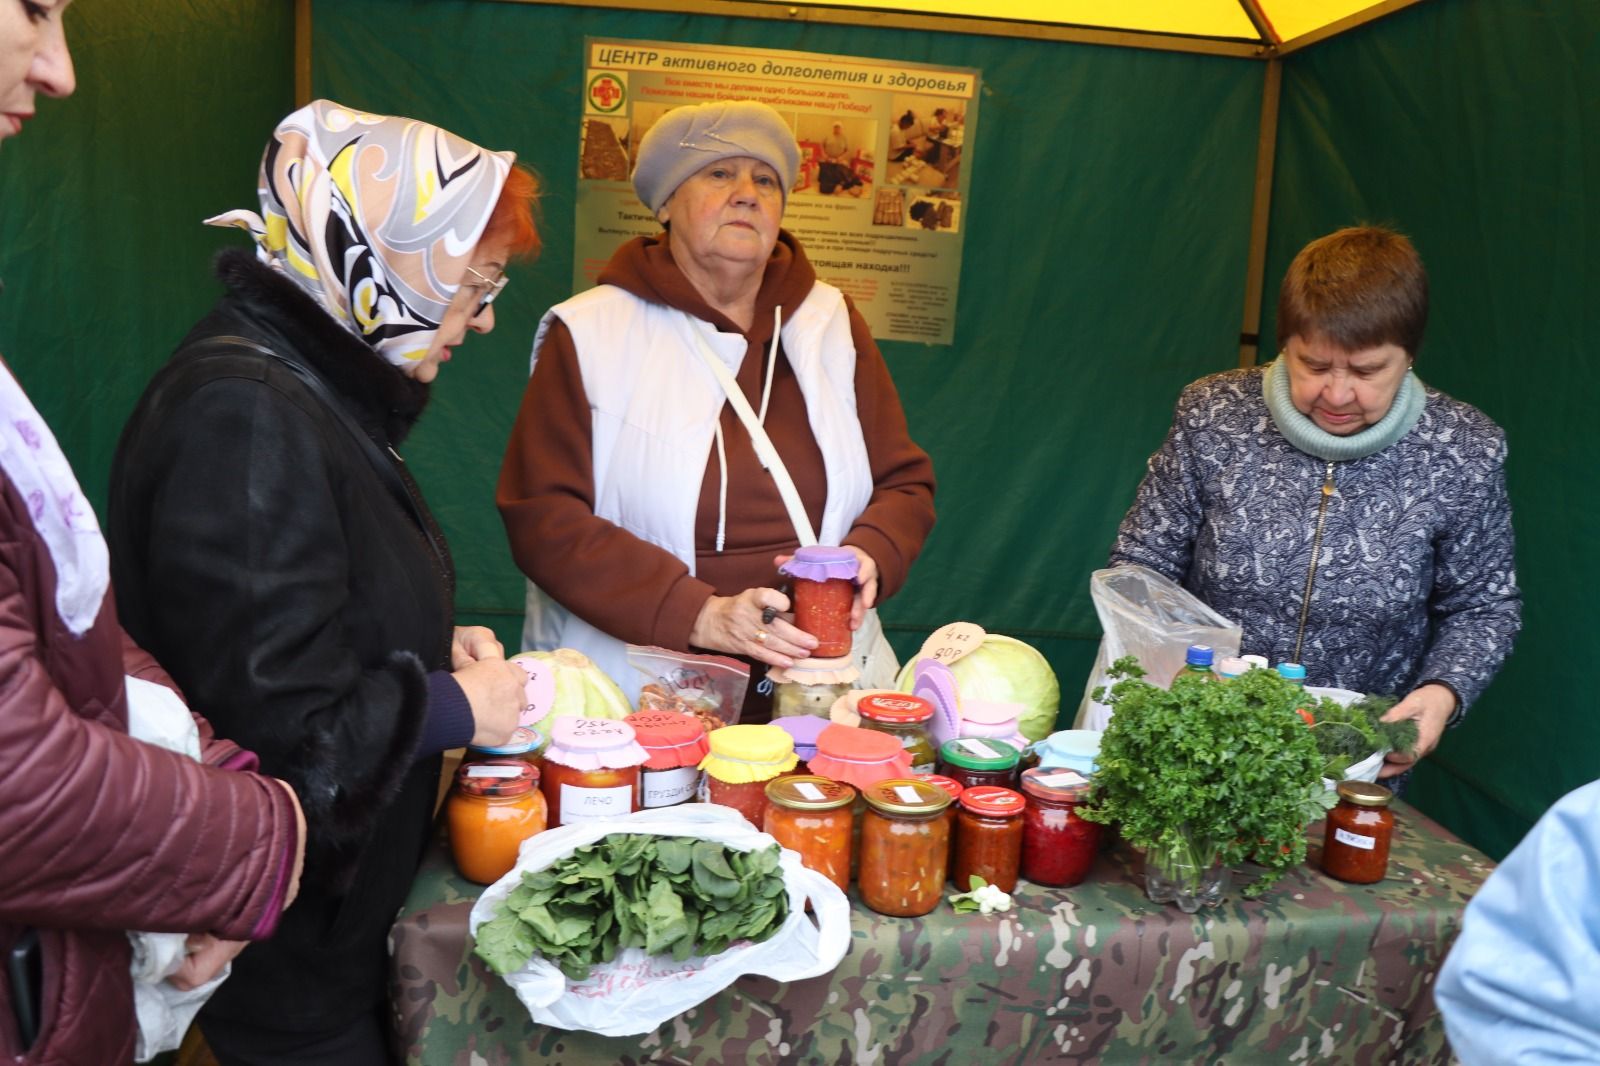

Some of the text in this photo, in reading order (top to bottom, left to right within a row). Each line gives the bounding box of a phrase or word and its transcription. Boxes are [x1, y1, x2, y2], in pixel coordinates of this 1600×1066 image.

[598, 48, 968, 93] ЦЕНТР активного долголетия и здоровья
[682, 79, 713, 90] вместе
[714, 81, 729, 90] мы
[730, 83, 763, 94] делаем
[787, 87, 825, 98] большое
[814, 100, 836, 111] нашу
[811, 259, 853, 270] тоящая
[583, 796, 614, 807] ЛЕЧО
